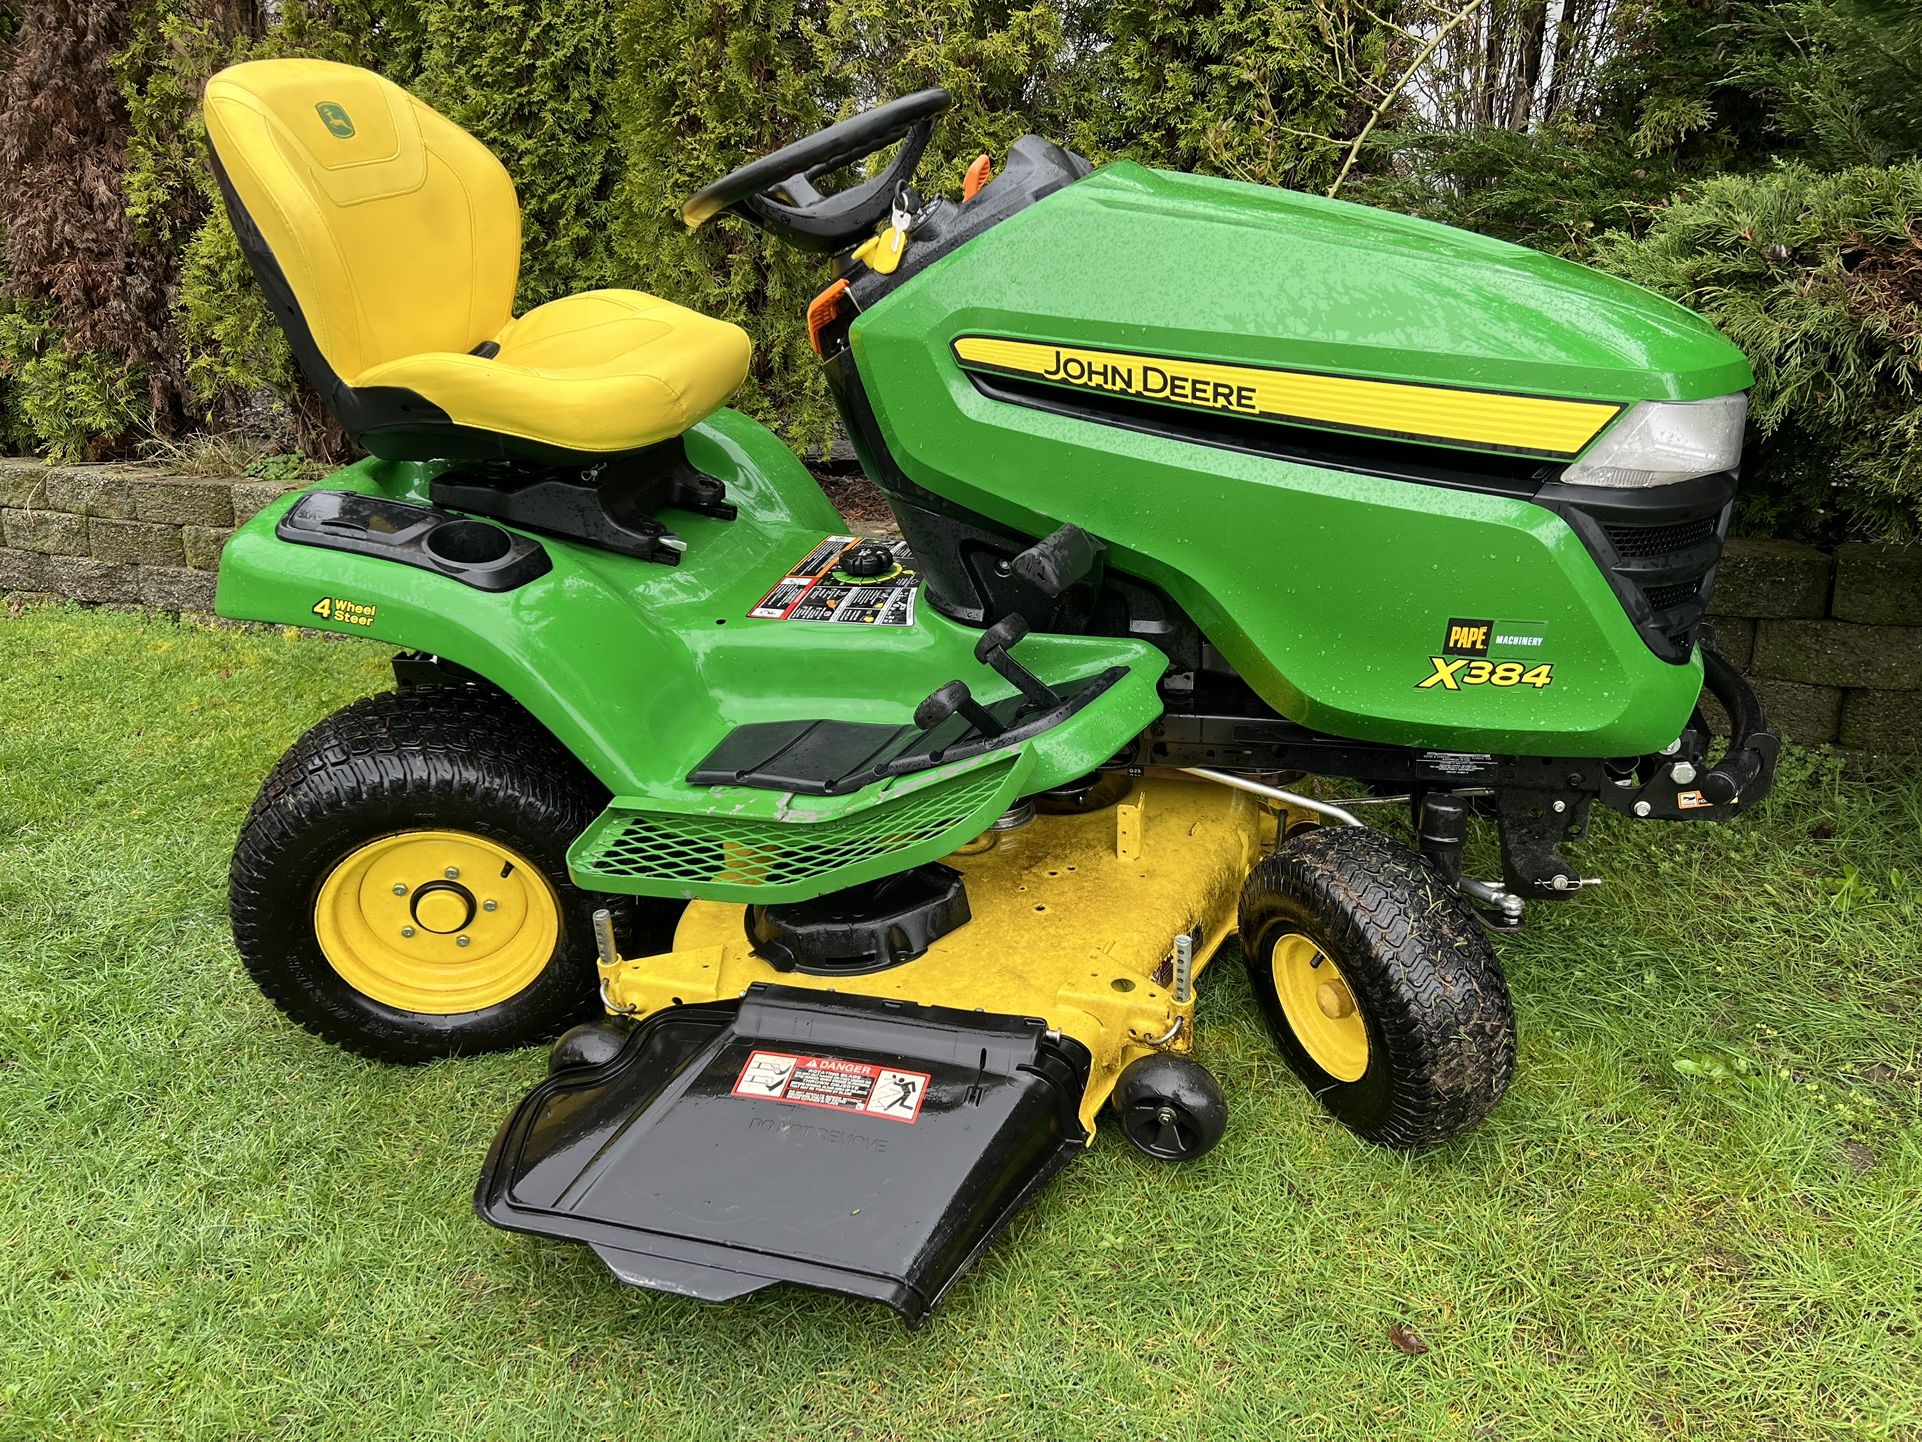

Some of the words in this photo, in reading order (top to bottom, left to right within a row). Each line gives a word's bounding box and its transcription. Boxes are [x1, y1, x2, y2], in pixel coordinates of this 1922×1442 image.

[1044, 350, 1132, 389] JOHN
[1142, 365, 1257, 409] DEERE
[312, 597, 332, 618] 4
[335, 599, 376, 616] Wheel
[334, 610, 374, 626] Steer
[1496, 635, 1543, 646] MACHINERY
[1413, 656, 1554, 691] X384
[820, 1060, 871, 1075] DANGER
